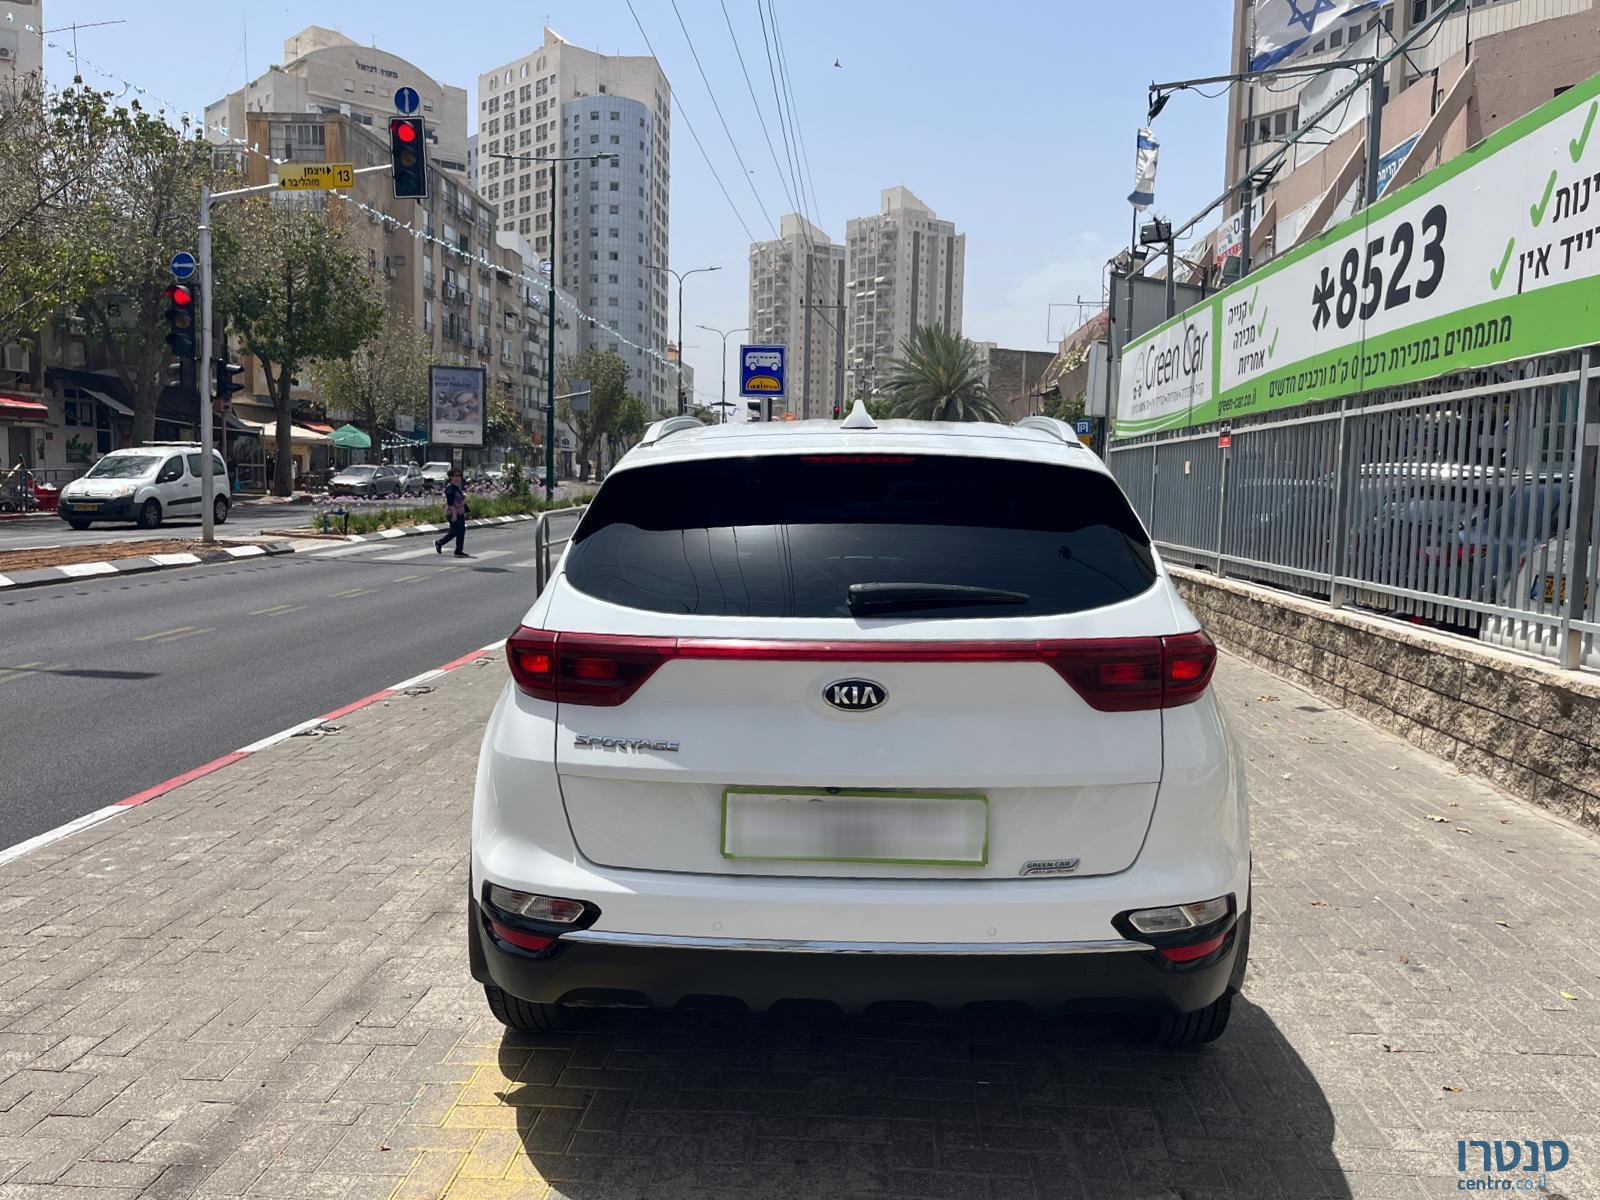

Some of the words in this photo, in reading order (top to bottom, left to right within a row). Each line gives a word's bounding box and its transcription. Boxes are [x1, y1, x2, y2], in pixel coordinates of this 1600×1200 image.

[287, 176, 320, 187] מוהליבר
[303, 167, 325, 177] ויצמן
[337, 169, 351, 183] 13
[1559, 226, 1600, 270] ייד
[1517, 243, 1552, 295] אין
[1227, 301, 1248, 326] קנייה
[1233, 324, 1256, 350] מכירה
[1443, 315, 1512, 357] מתמחים
[1145, 344, 1180, 391] Green
[1182, 323, 1209, 376] Car
[1237, 349, 1266, 375] אחריות
[1388, 336, 1440, 371] במכירת
[1299, 366, 1328, 392] ורכבים
[1351, 354, 1358, 380] 0
[1268, 375, 1297, 399] חדשים
[1217, 388, 1257, 416] green-car.co.il
[833, 686, 878, 704] KIA
[573, 734, 681, 752] SPORTAGE
